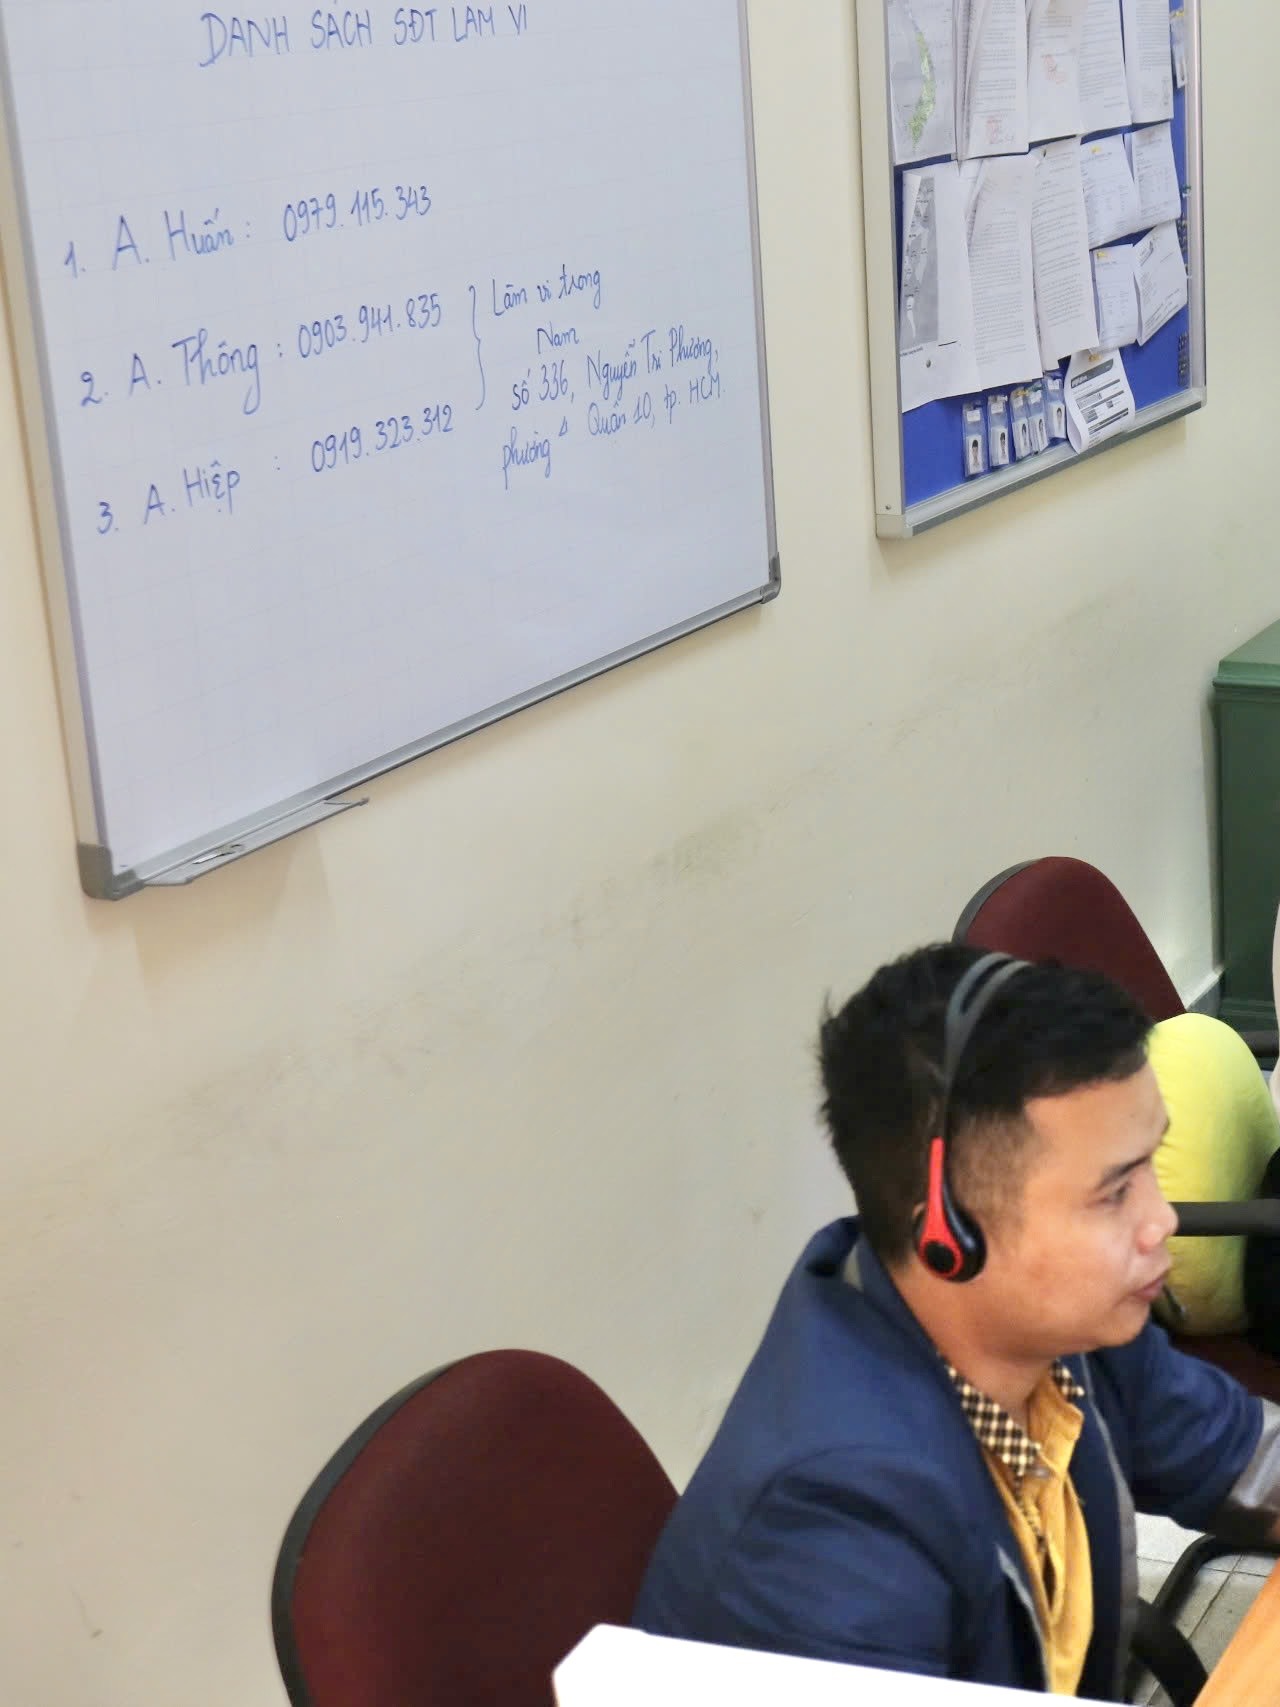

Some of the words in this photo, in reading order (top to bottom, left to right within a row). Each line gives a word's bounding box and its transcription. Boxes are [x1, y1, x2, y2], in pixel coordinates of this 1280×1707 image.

[199, 12, 290, 67] DANH
[394, 8, 437, 45] SĐT
[112, 215, 150, 270] A.
[558, 264, 600, 310] trong
[537, 320, 580, 354] Nam
[129, 353, 162, 396] A.
[143, 484, 176, 524] A.
